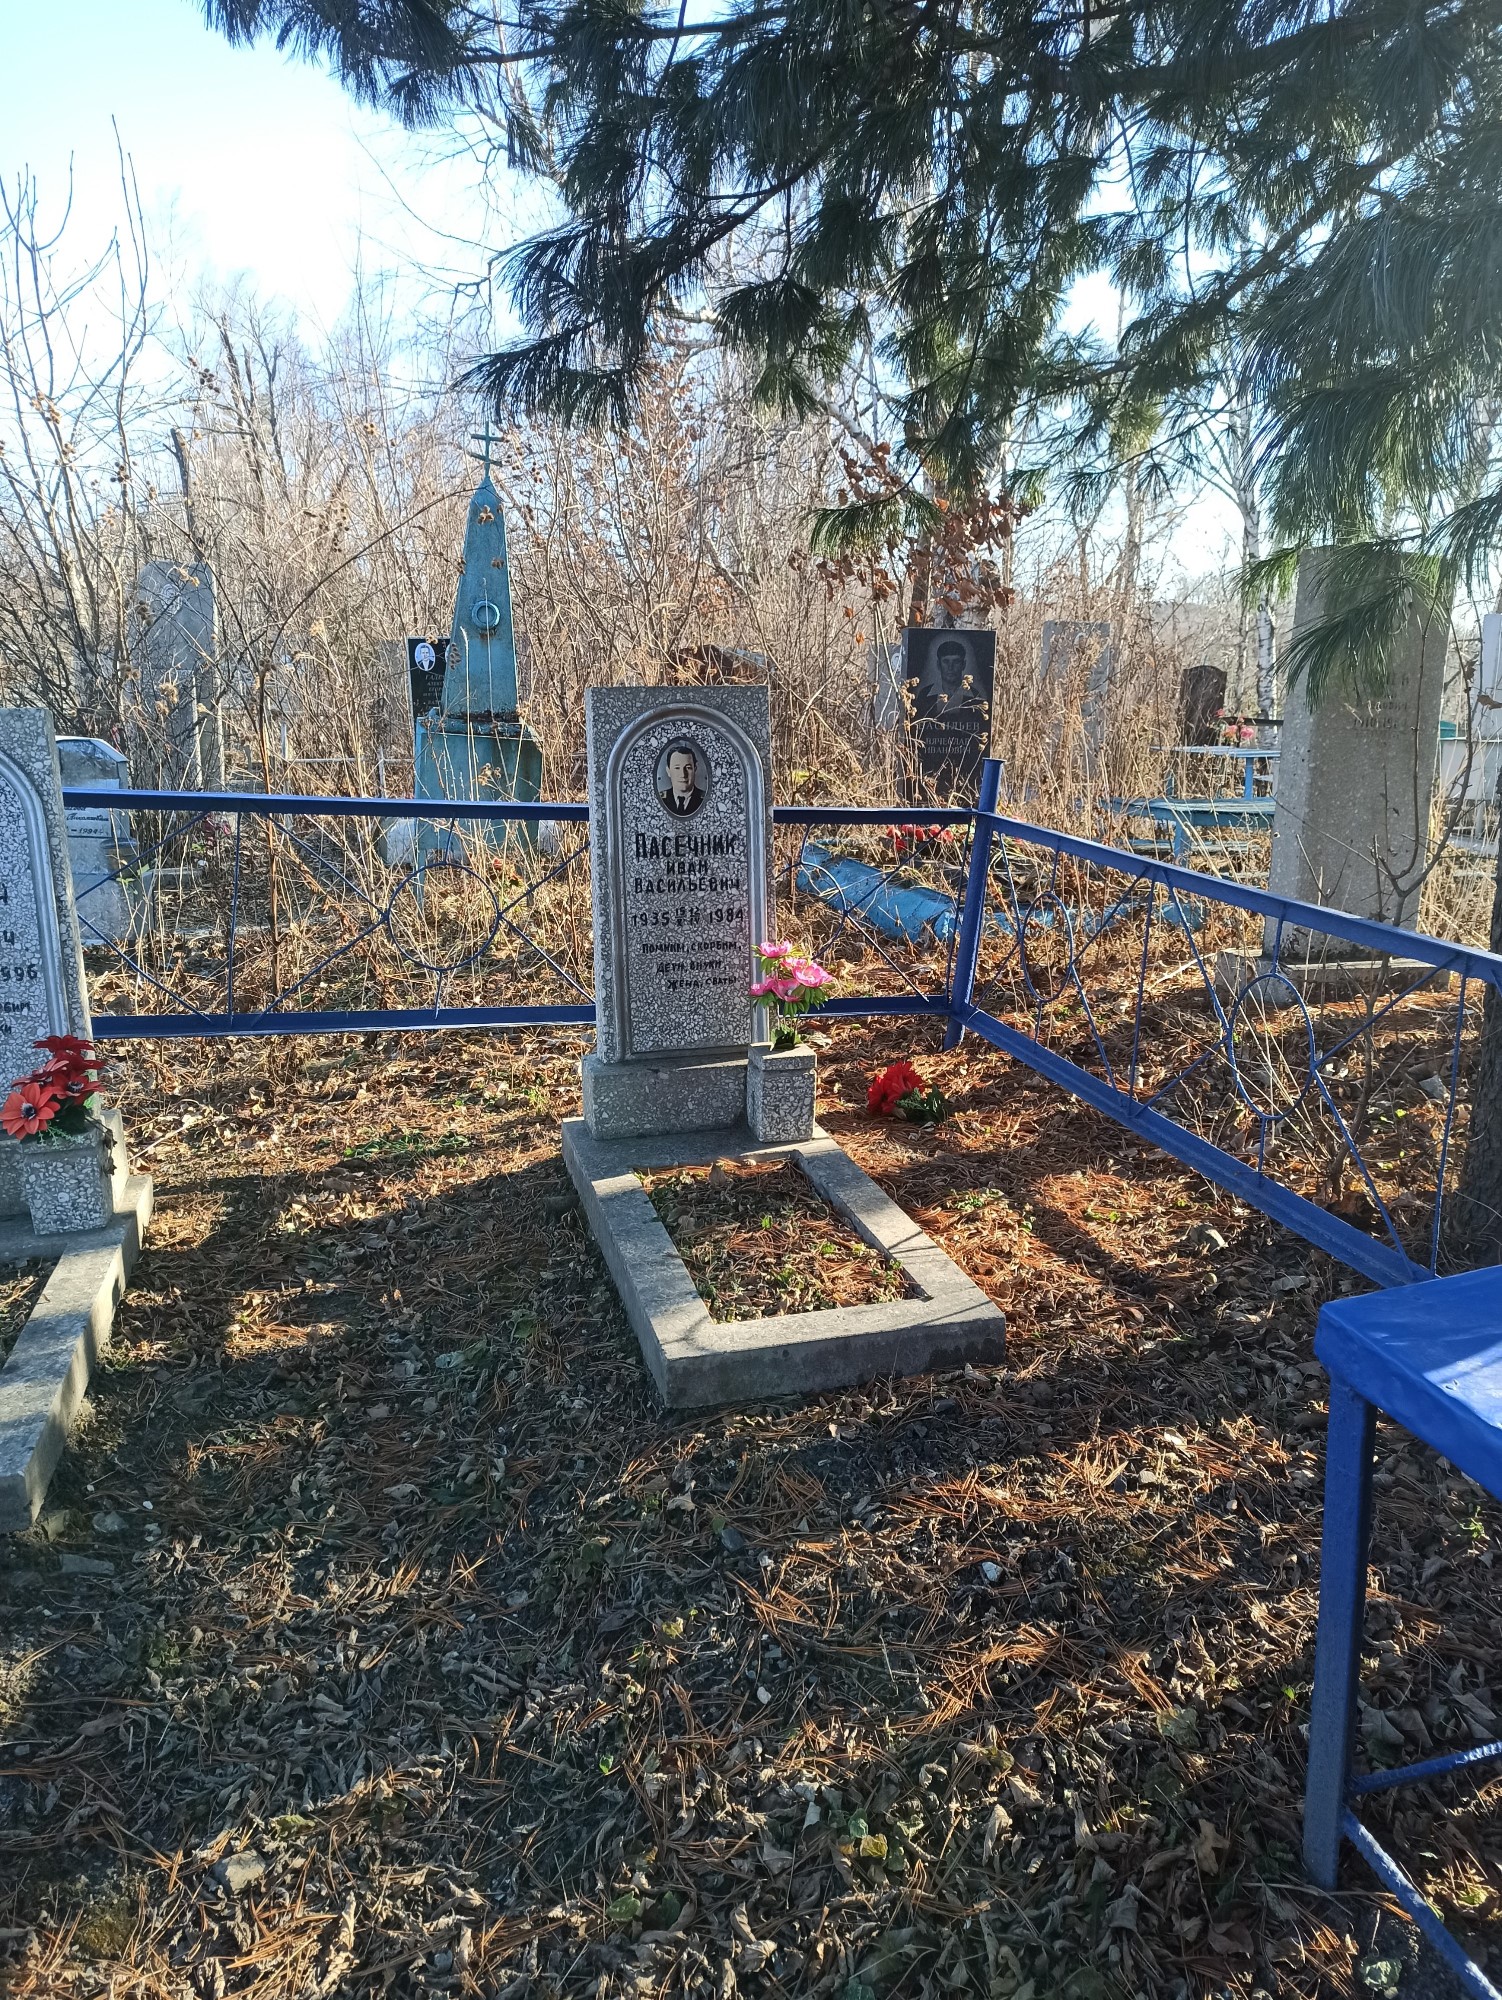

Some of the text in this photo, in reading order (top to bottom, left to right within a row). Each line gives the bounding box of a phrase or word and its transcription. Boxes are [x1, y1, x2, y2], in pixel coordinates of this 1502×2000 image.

[635, 833, 738, 861] ПАСЕЧНИК
[666, 860, 708, 876] ИВАН
[635, 877, 740, 894] ВАСИЛЬЕВИЧ
[631, 911, 671, 927] 1935
[709, 908, 743, 924] 1984
[0, 964, 38, 982] 996
